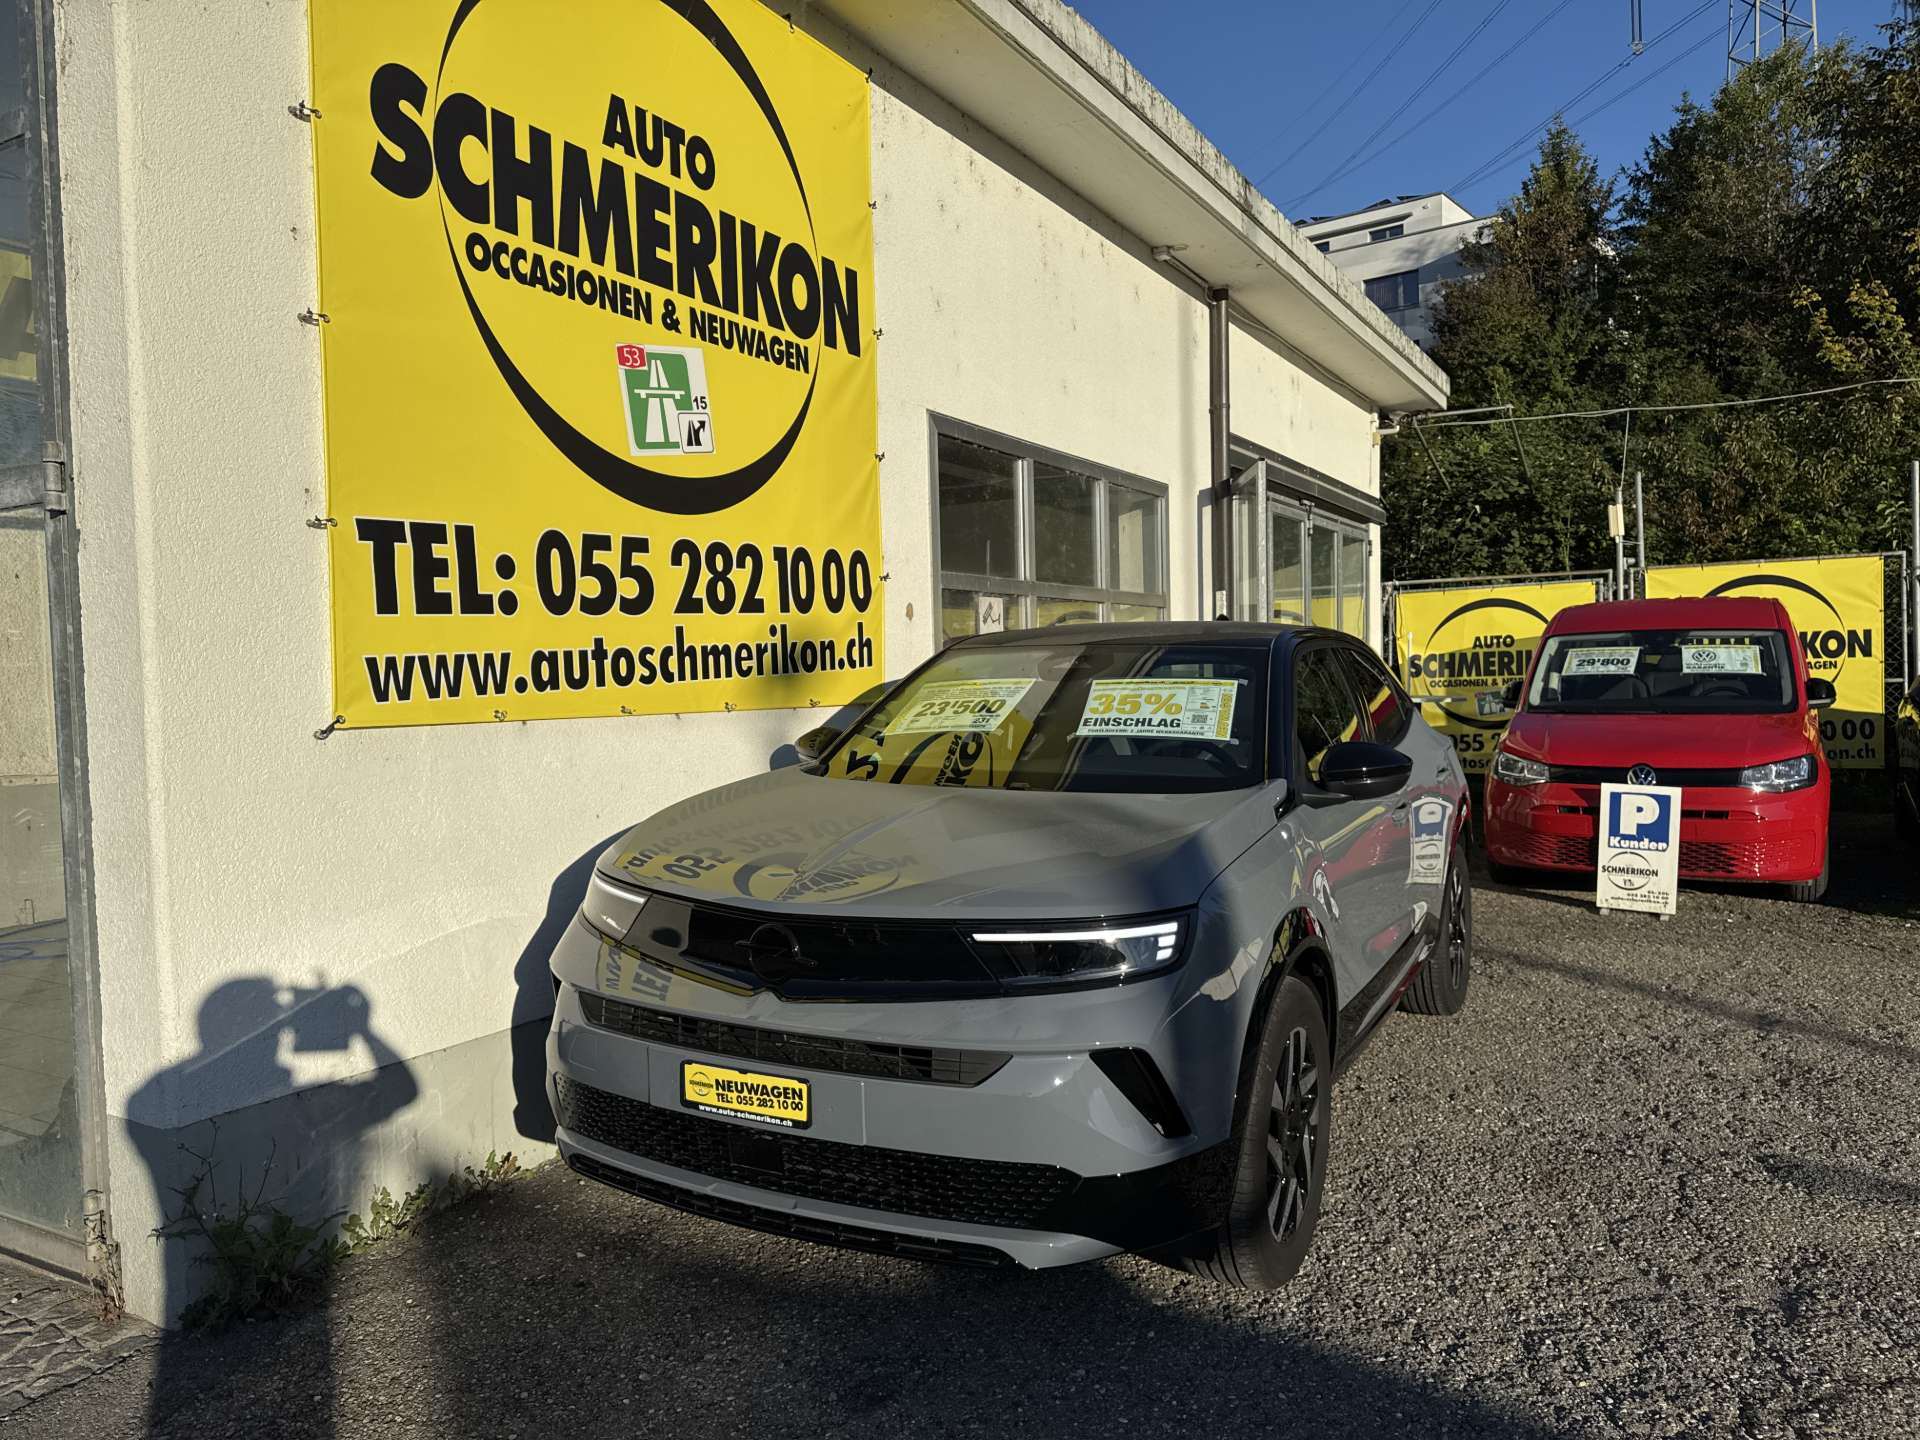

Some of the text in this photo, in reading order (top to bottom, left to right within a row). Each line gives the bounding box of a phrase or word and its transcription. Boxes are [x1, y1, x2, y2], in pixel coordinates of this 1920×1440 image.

[602, 93, 716, 191] AUTO
[369, 62, 861, 358] SCHMERIKON
[465, 231, 810, 374] OCCASIONEN & NEUWAGEN
[623, 347, 641, 367] 53
[693, 396, 708, 410] 15
[354, 516, 519, 616] TEL:
[535, 529, 655, 616] 055
[670, 538, 765, 614] 282
[1472, 635, 1515, 649] AUTO
[365, 621, 873, 703] www.autoschmerikon.ch
[1409, 650, 1532, 678] SCHMERI
[1576, 658, 1630, 667] 29'800
[1807, 660, 1837, 670] AGEN
[1430, 678, 1488, 688] OCCASIONEN
[1491, 678, 1498, 687] &
[914, 699, 1006, 718] 23'500
[1088, 693, 1182, 715] 35%
[1083, 717, 1181, 728] EINSCHLAG
[1620, 793, 1660, 835] P
[1609, 835, 1668, 851] Kunden
[1601, 865, 1659, 877] SCHMERIKON
[715, 1079, 803, 1101] NEUWAGEN
[716, 1093, 803, 1112] TEL: 055 282 10 00
[699, 1104, 793, 1127] www.auto-schmerikon.ch
